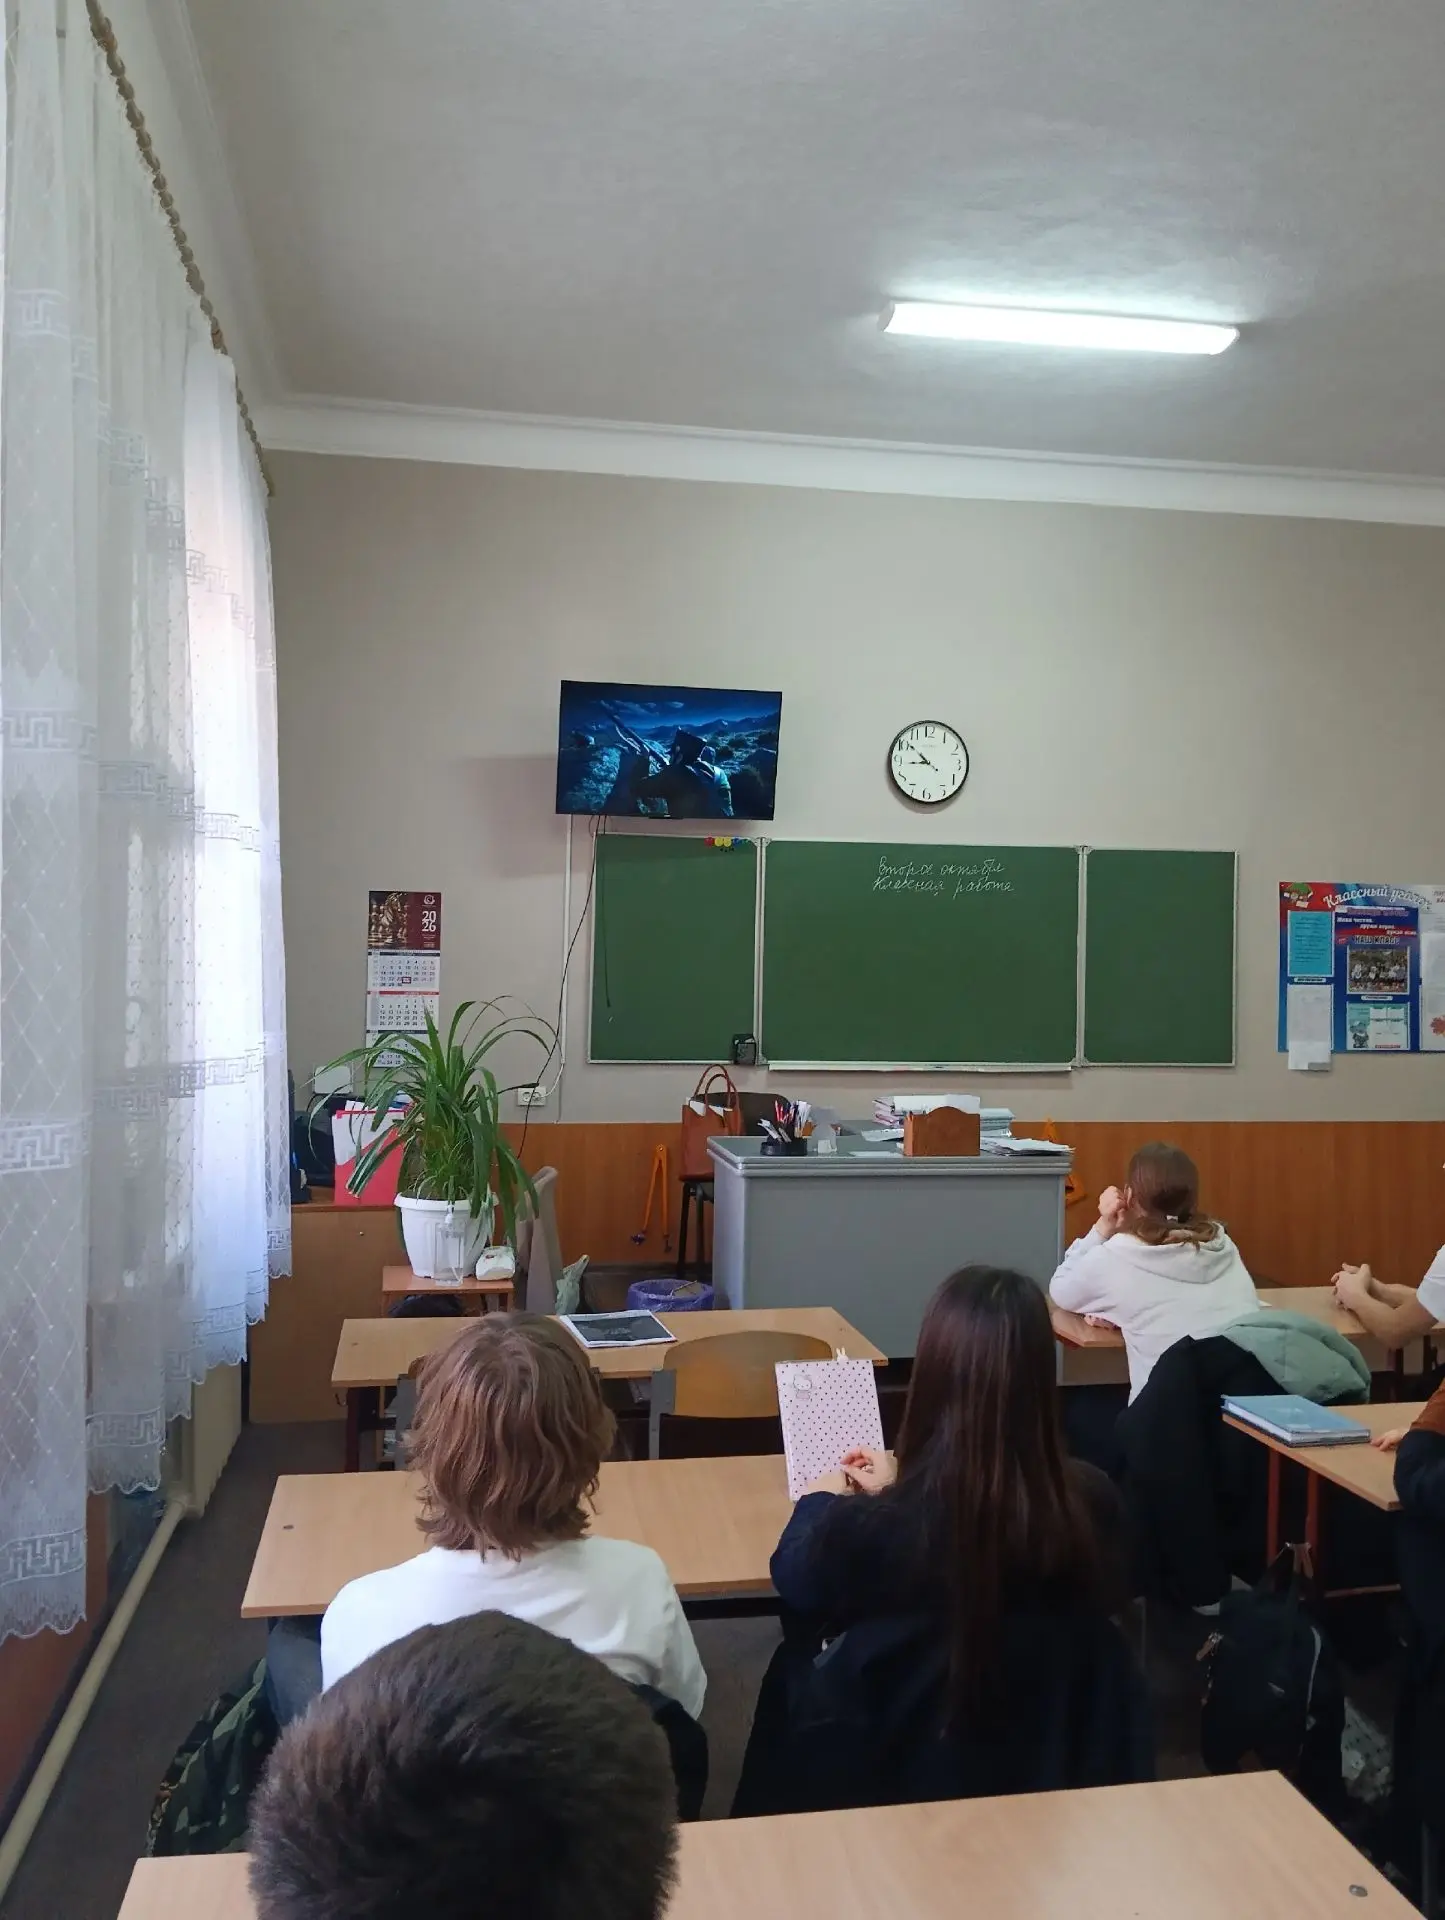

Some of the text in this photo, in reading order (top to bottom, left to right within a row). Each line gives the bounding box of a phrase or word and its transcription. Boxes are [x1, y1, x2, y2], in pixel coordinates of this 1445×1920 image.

[910, 727, 919, 741] 11
[924, 725, 936, 739] 12
[942, 731, 947, 744] 1
[898, 739, 910, 752] 10
[950, 743, 959, 756] 2
[893, 754, 903, 767] 9
[922, 788, 932, 800] 6
[952, 876, 1015, 901] работа
[1323, 884, 1388, 909] Классный
[1388, 888, 1433, 912] уголок
[421, 910, 437, 922] 20
[421, 920, 437, 933] 26
